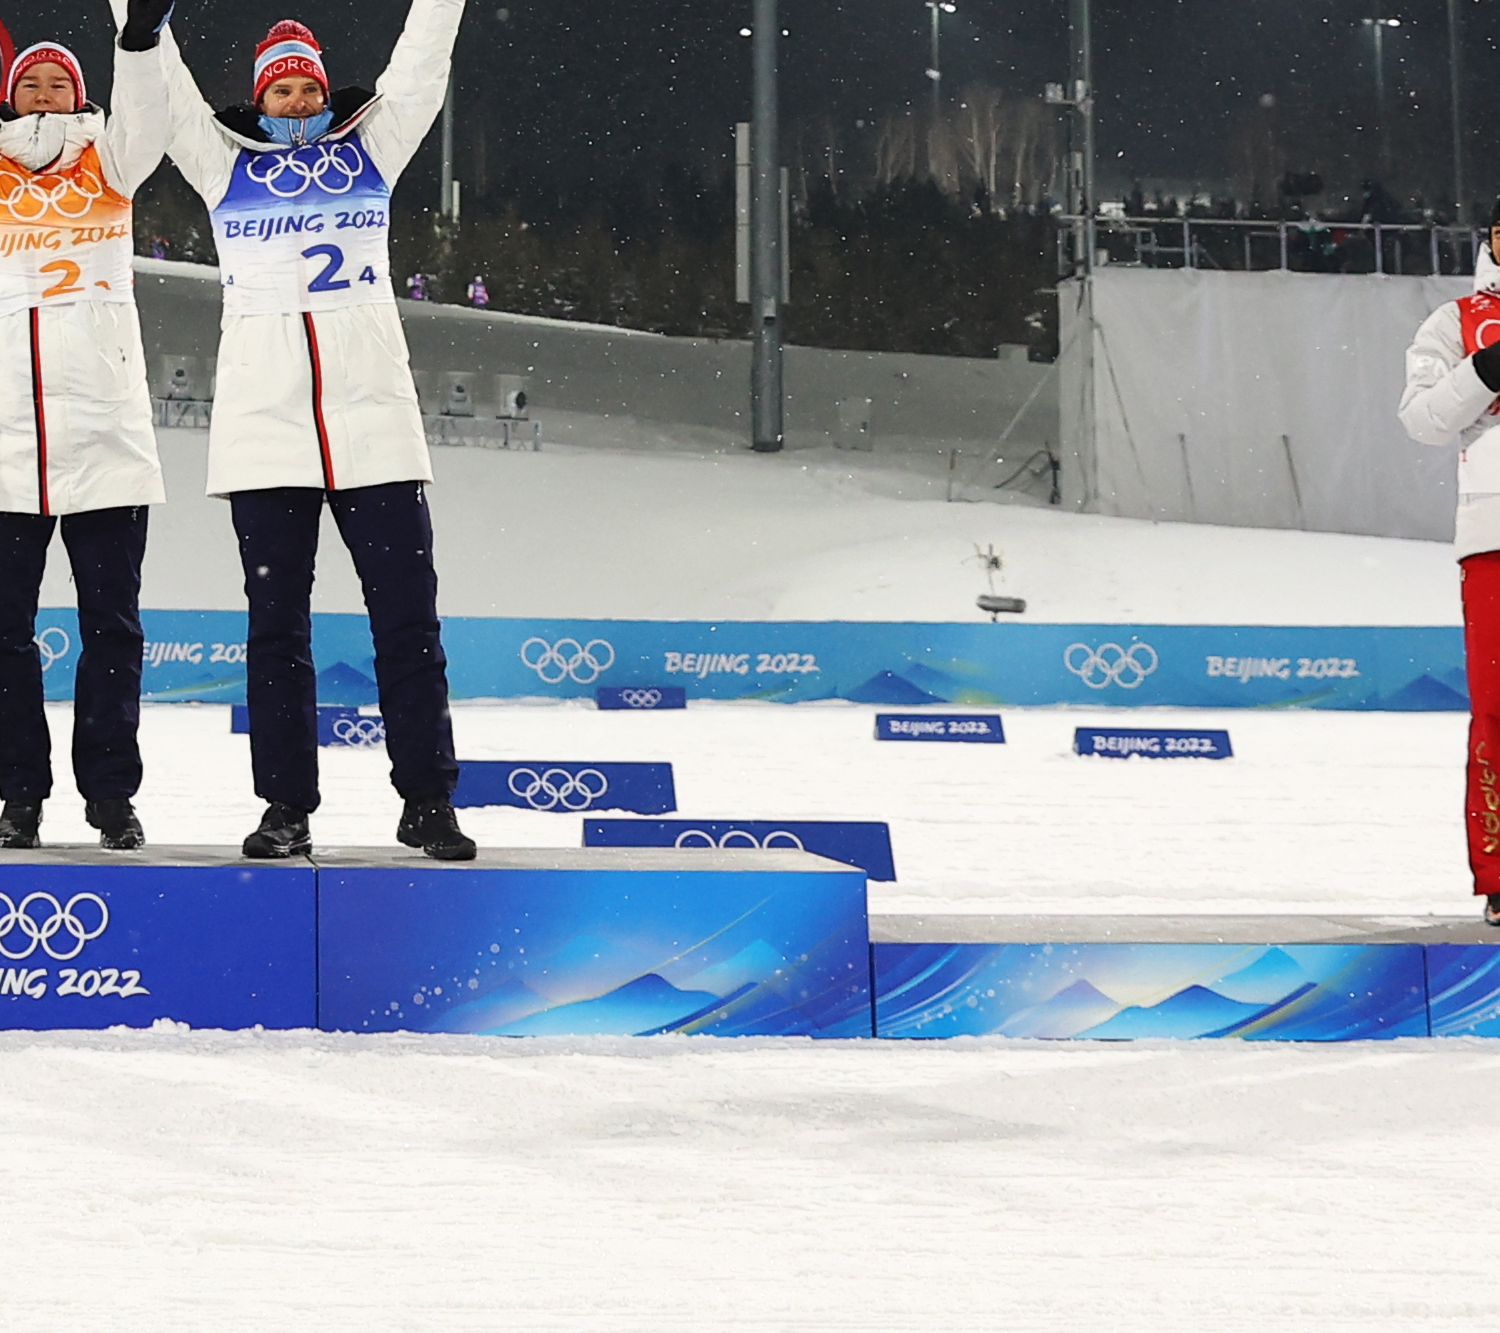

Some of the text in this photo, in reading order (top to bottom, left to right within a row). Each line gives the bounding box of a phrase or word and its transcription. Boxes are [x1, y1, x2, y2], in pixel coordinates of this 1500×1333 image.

[264, 58, 322, 79] NORGE
[223, 209, 388, 242] BEIJING 2022
[39, 259, 85, 299] 2
[301, 243, 352, 293] 2
[359, 265, 377, 285] 4
[142, 641, 204, 668] EIJING
[665, 652, 820, 679] BEIJING 2022
[1206, 655, 1361, 683] BEIJING 2022
[889, 720, 992, 737] BEIJING 2022
[1091, 735, 1218, 755] BEIJING 2022
[56, 968, 150, 998] 2022
